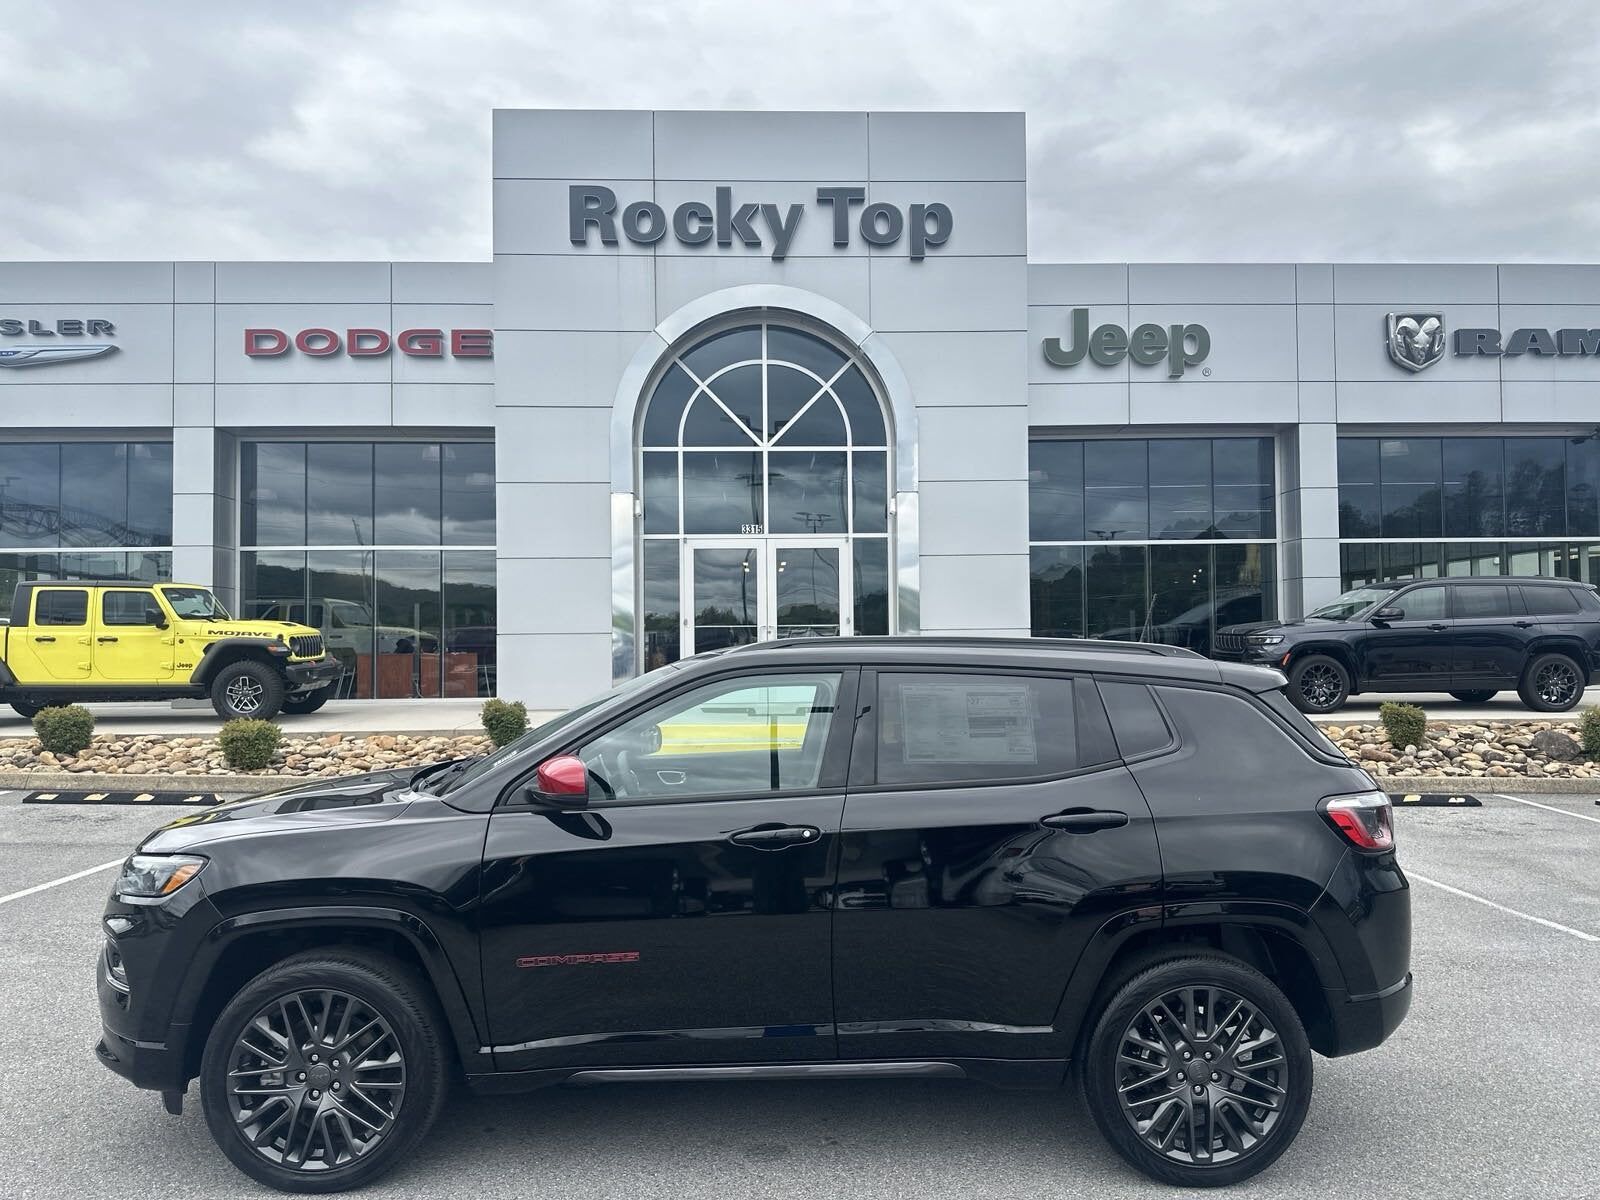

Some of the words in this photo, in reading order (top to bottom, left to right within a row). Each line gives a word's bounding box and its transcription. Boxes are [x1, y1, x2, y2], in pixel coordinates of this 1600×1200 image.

[569, 185, 805, 261] Rocky
[817, 187, 953, 261] Top
[0, 319, 115, 336] SLER
[1042, 308, 1211, 378] Jeep
[244, 328, 494, 359] DODGE
[516, 952, 640, 967] COMPASS
